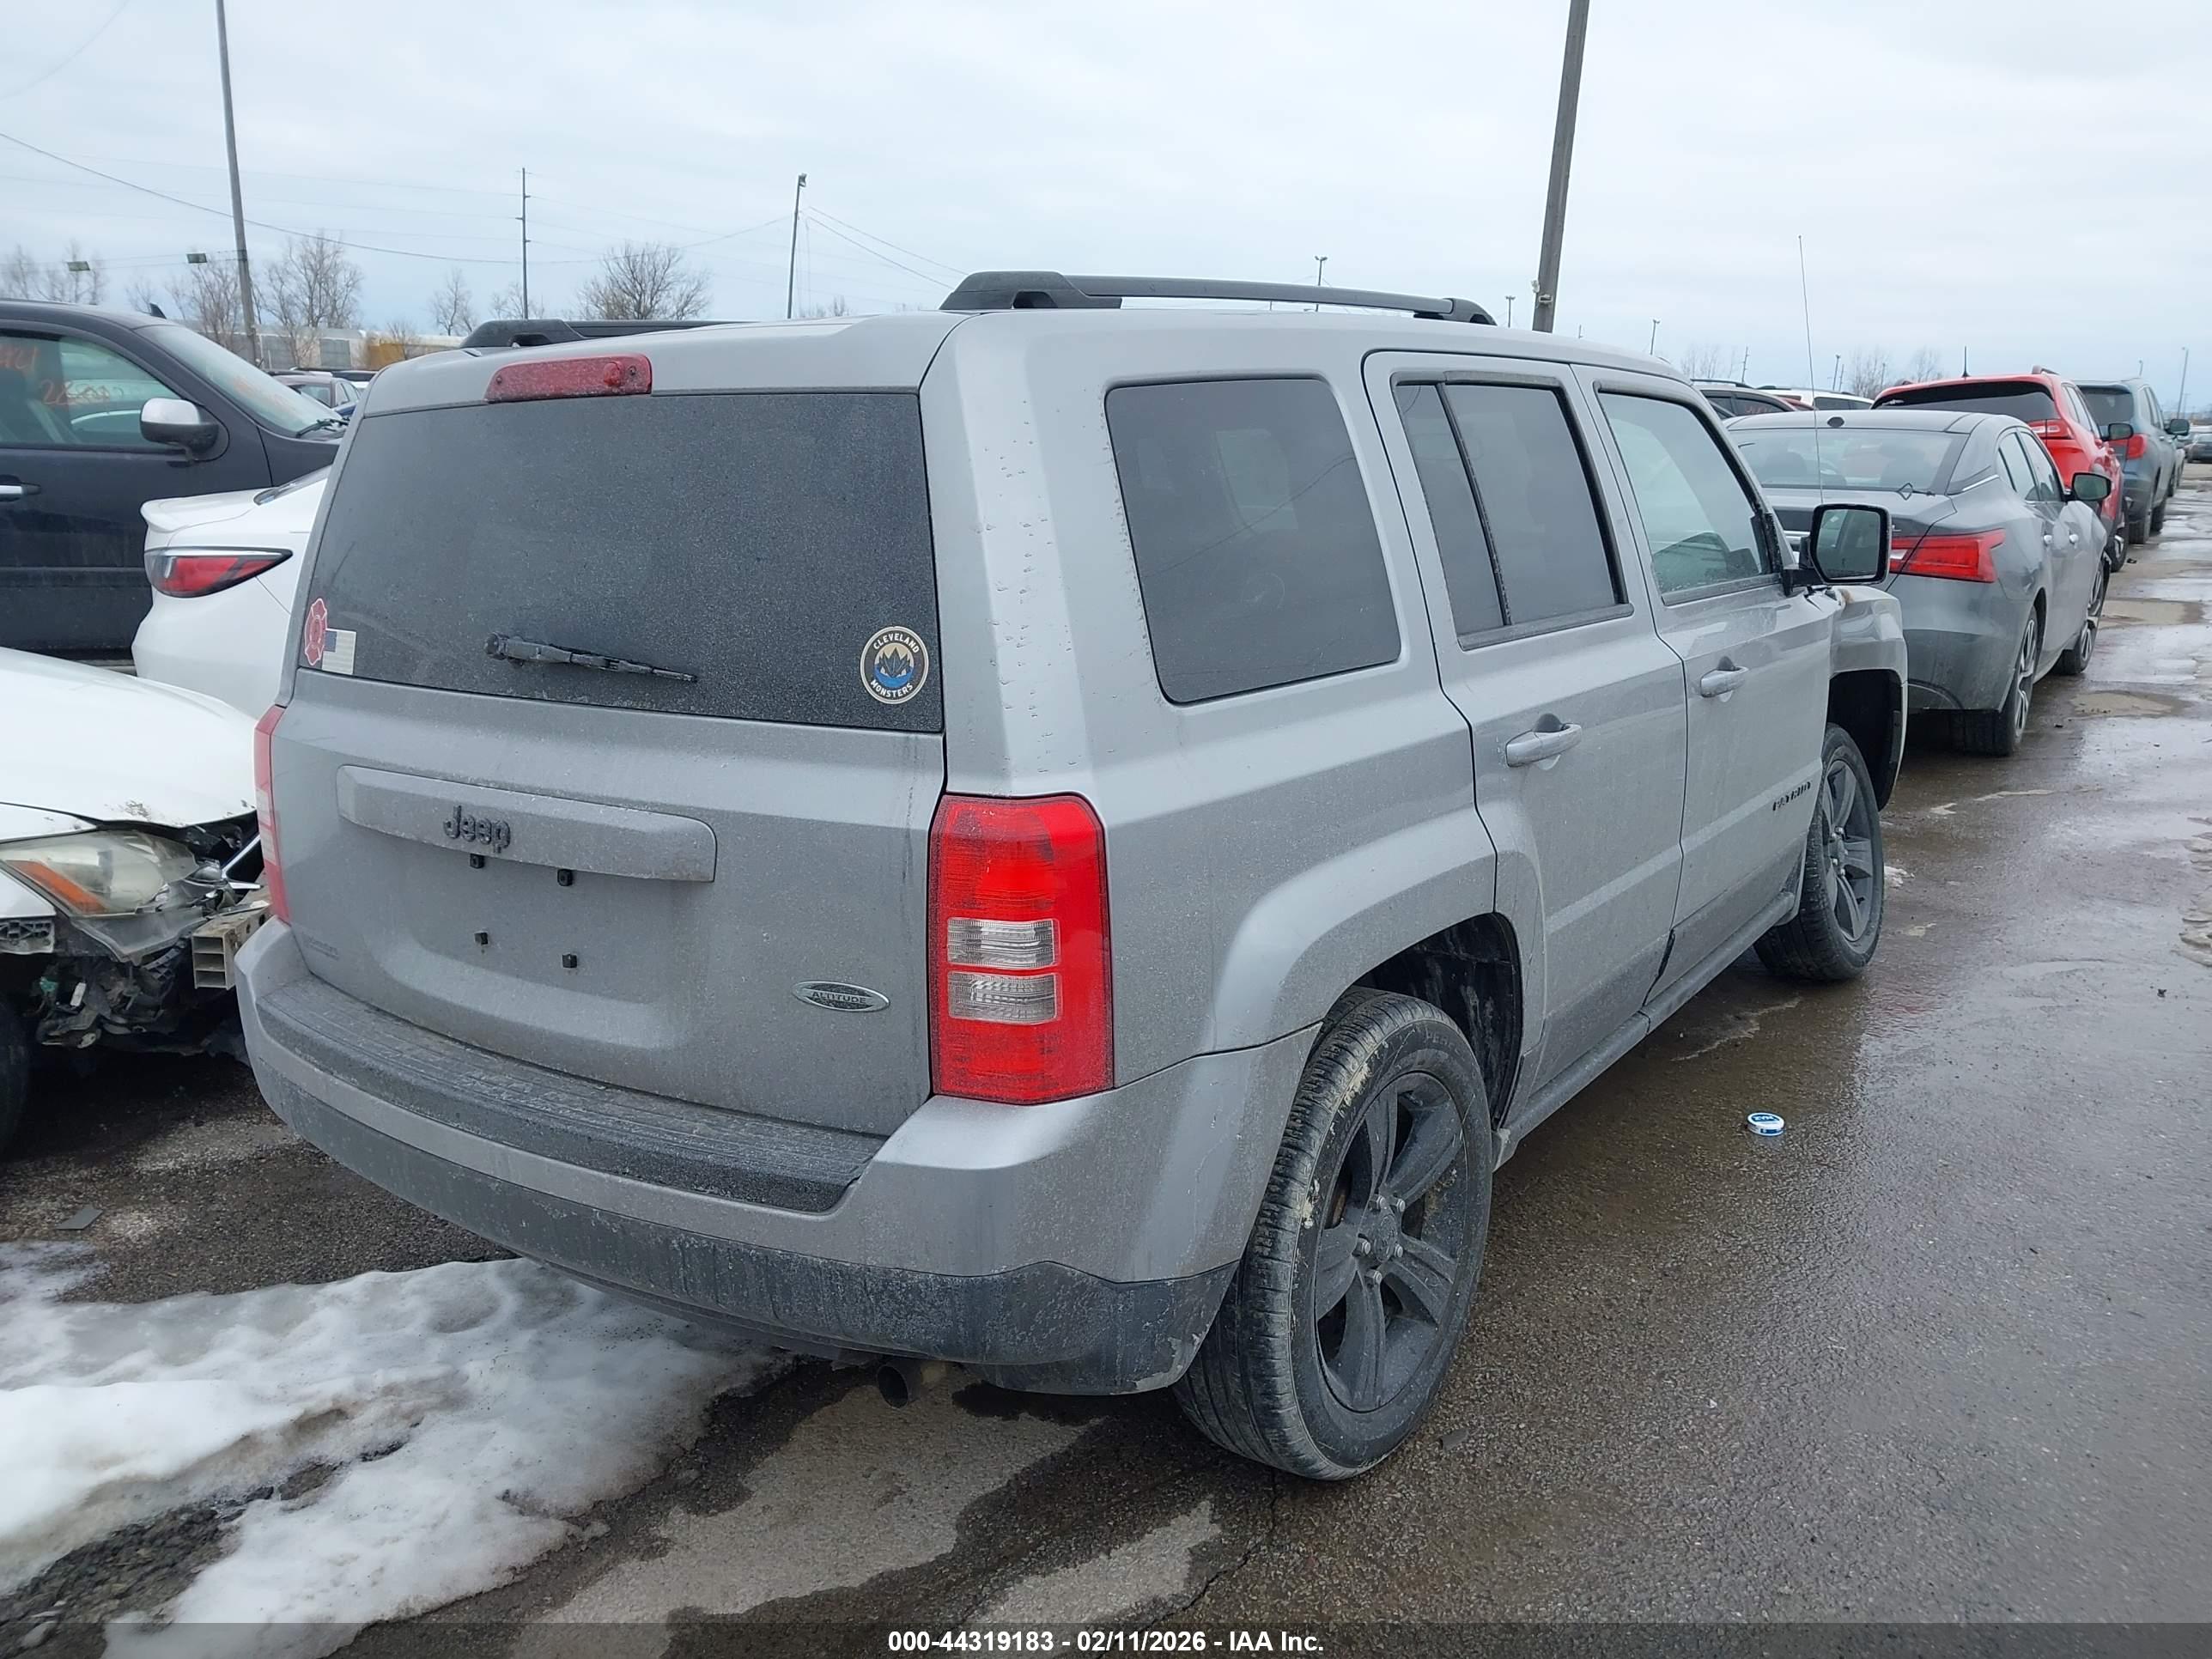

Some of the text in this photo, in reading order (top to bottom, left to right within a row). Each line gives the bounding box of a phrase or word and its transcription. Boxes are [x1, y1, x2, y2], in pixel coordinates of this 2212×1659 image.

[873, 633, 920, 653] CLEVELAND
[870, 678, 913, 697] MONSTERS
[443, 805, 510, 854] Jeep
[811, 991, 866, 1004] ALTITUDE
